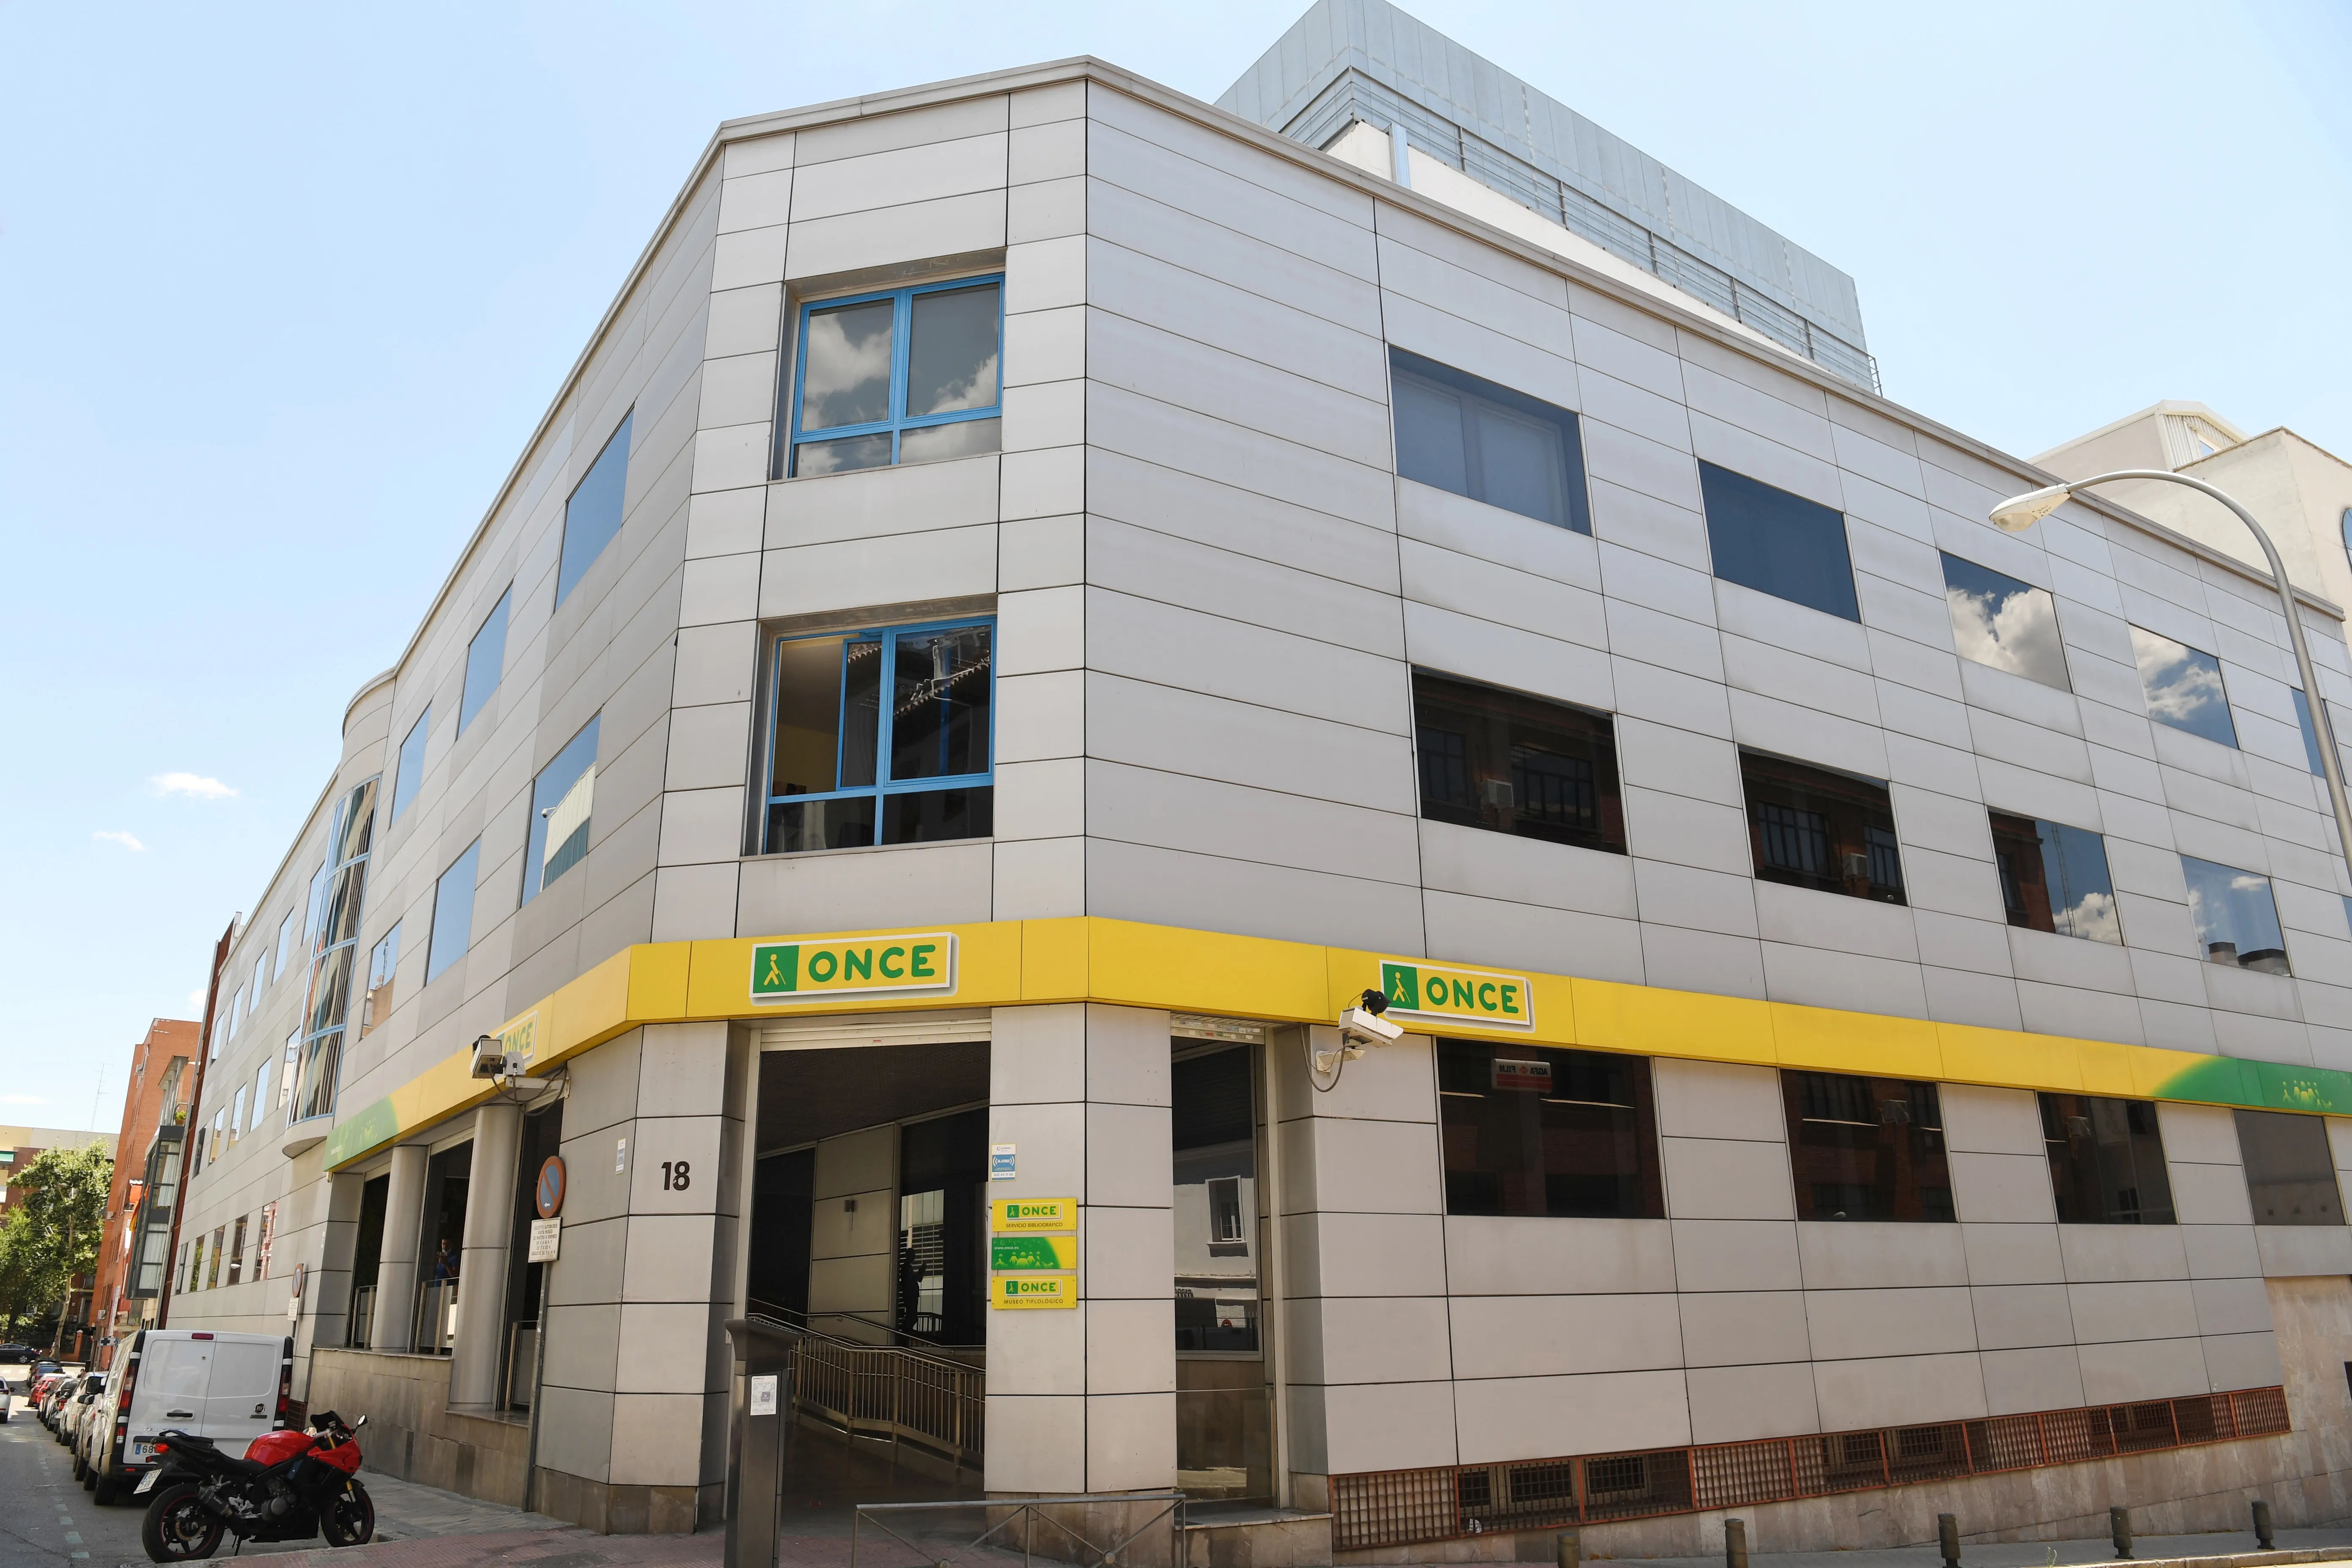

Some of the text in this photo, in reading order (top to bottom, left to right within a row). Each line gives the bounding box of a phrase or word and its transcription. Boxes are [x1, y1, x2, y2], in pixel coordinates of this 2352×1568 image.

[808, 945, 936, 982] ONCE
[1426, 977, 1519, 1013] ONCE
[505, 1021, 532, 1054] ONCE
[661, 1161, 690, 1191] 18
[1022, 1206, 1056, 1215] ONCE
[1021, 1282, 1056, 1292] ONCE
